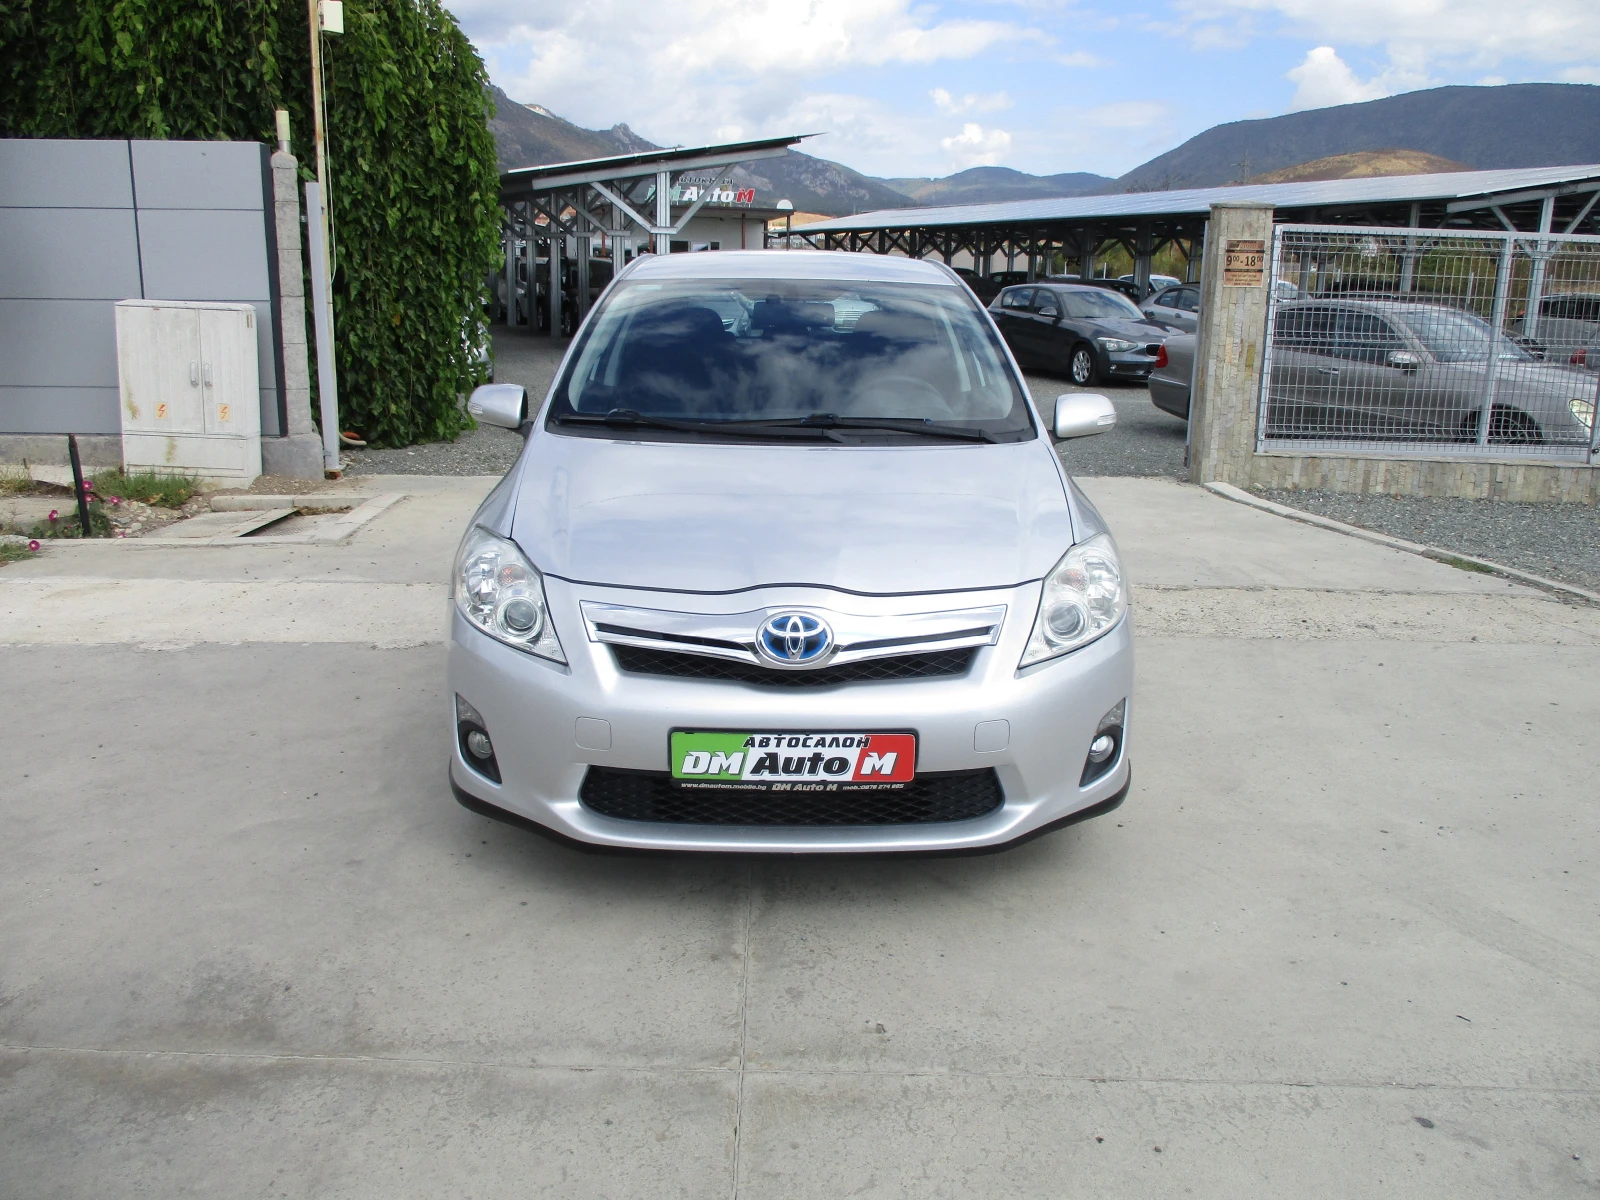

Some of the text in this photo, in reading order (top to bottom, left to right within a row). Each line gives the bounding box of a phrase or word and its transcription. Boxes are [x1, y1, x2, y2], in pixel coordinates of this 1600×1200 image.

[736, 188, 755, 203] M
[742, 736, 871, 748] АВТОСАЛОН
[681, 751, 898, 776] DM Auto M
[793, 783, 824, 791] Auto
[825, 783, 839, 791] M
